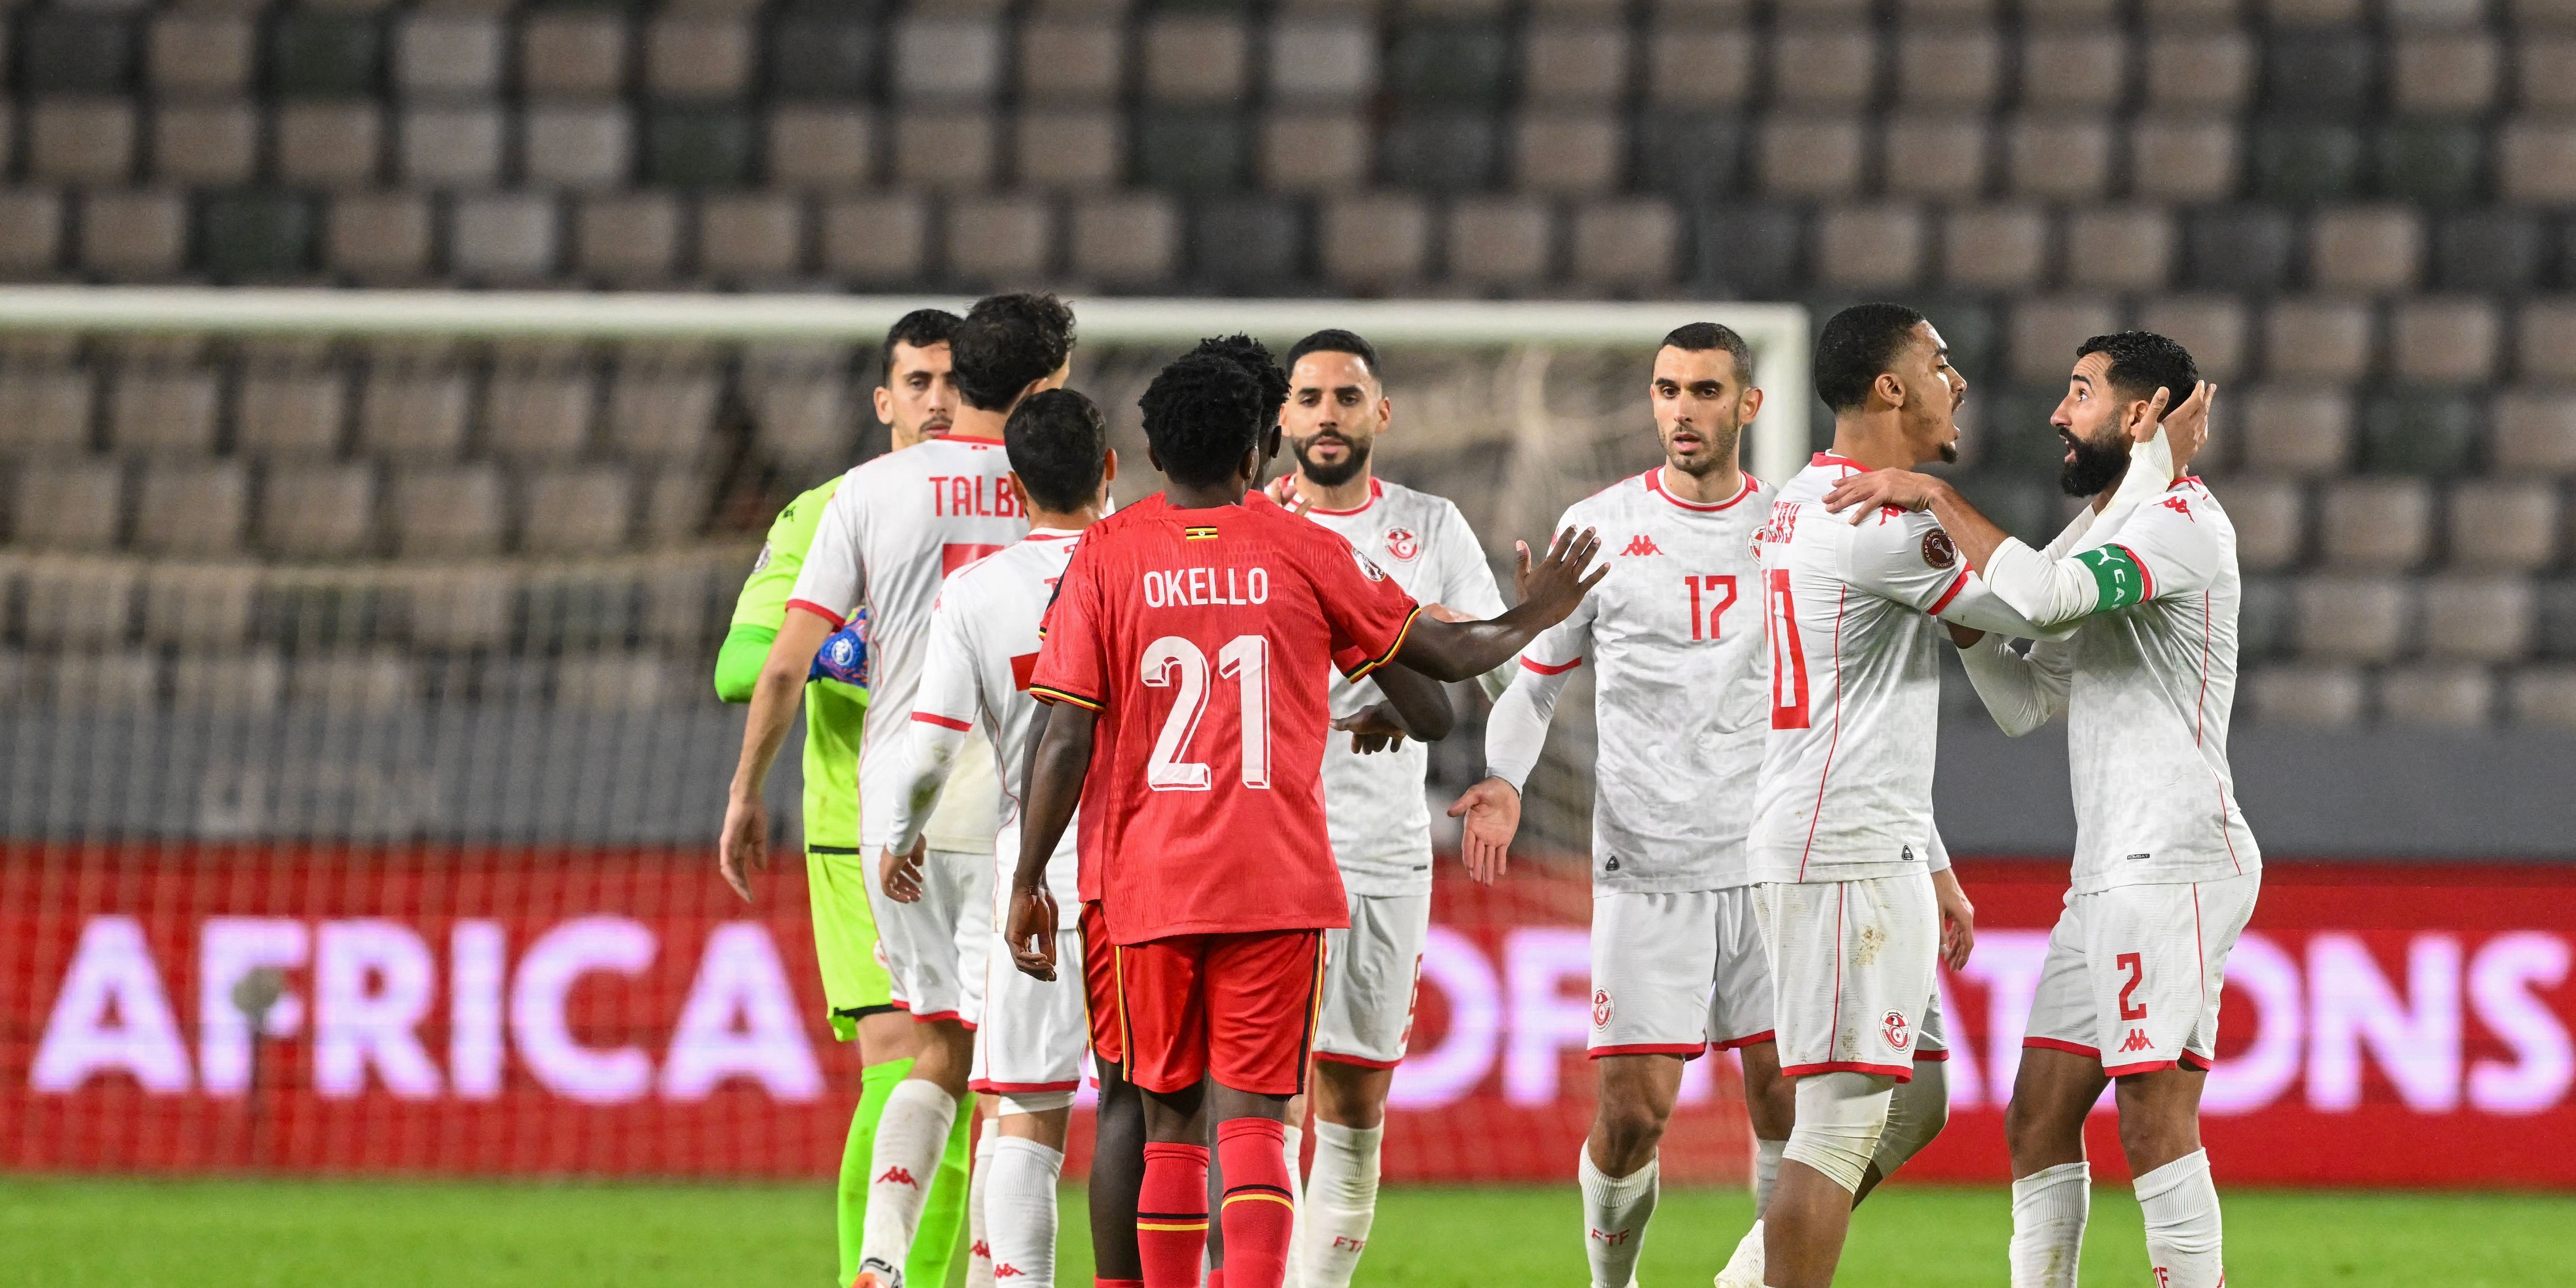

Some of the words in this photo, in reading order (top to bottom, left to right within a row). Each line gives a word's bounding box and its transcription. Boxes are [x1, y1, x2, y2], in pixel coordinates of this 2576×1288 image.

[1143, 567, 1268, 608] OKELLO
[1685, 575, 1737, 640] 17
[1141, 634, 1270, 792] 21
[29, 915, 828, 1104] AFRICA
[2117, 952, 2147, 1021] 2
